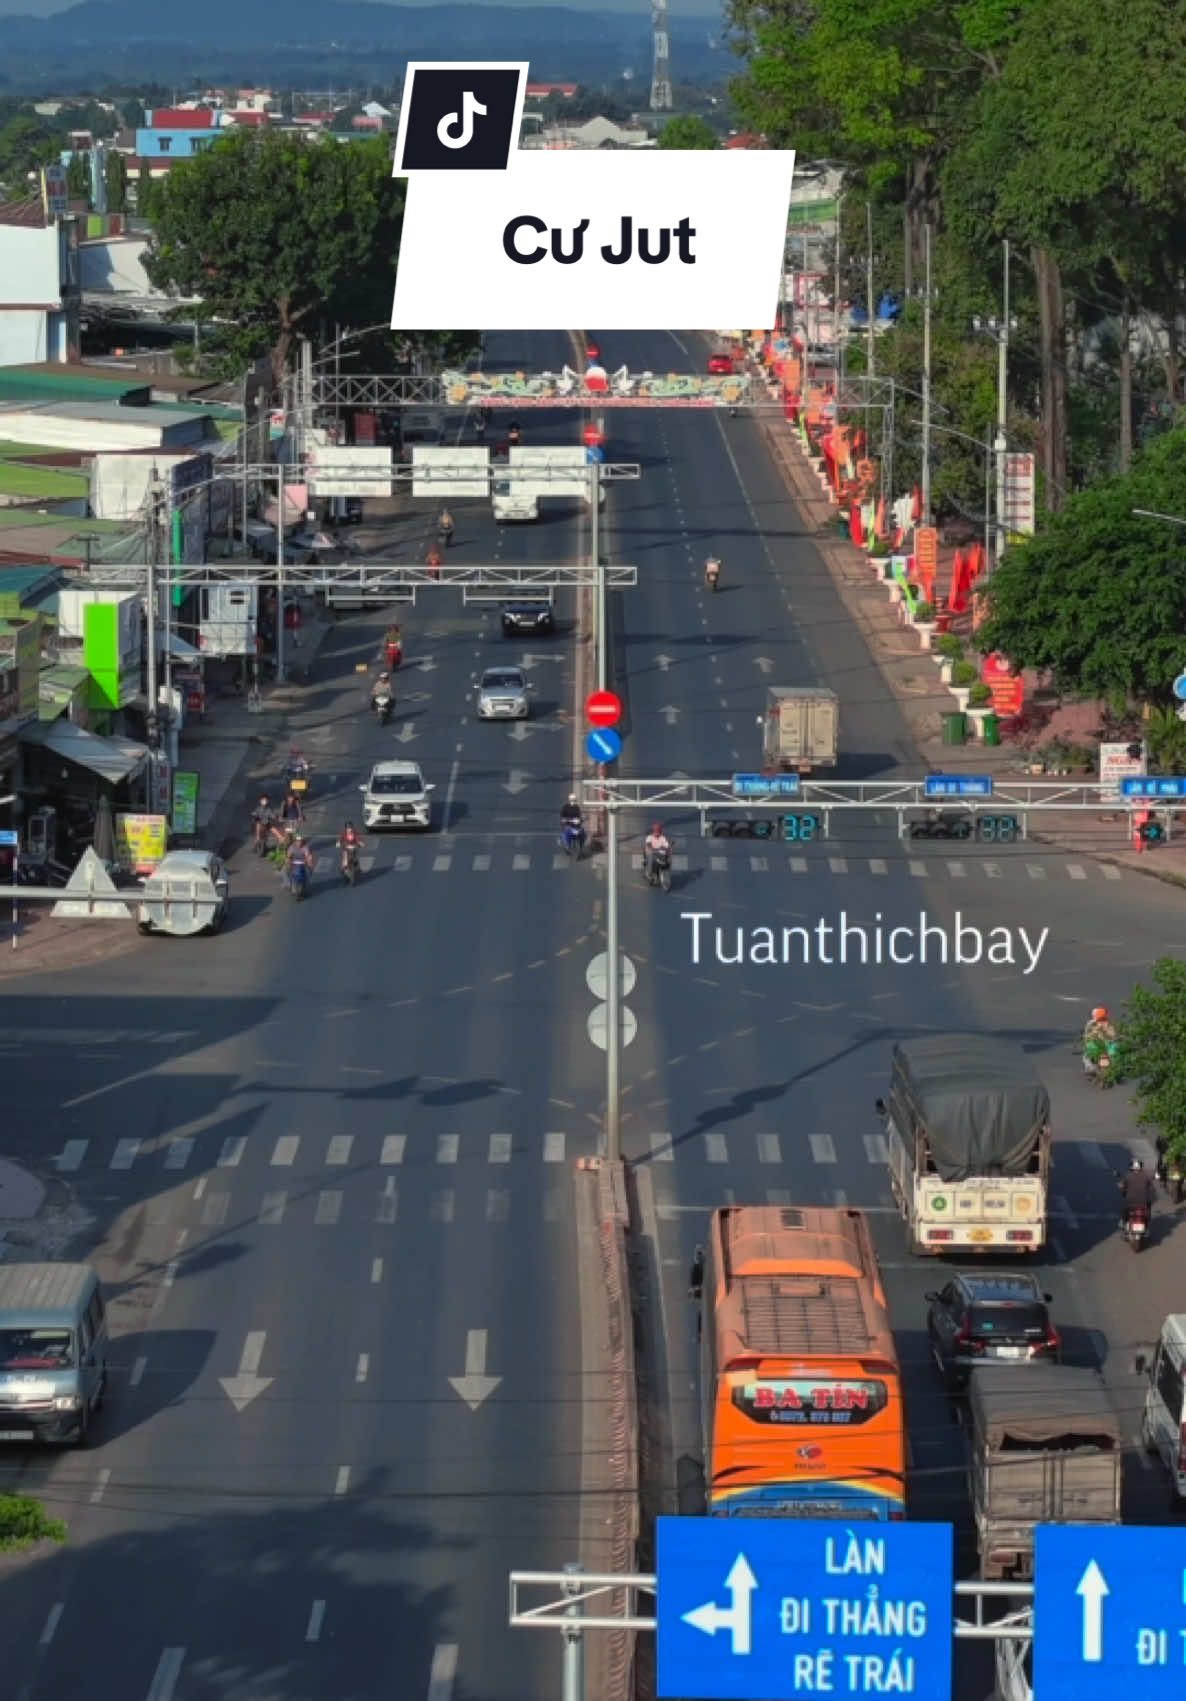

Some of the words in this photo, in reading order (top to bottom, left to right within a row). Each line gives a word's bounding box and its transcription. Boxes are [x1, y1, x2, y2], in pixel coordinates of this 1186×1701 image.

[783, 814, 817, 841] 32
[753, 1386, 803, 1408] BA
[825, 1528, 886, 1575] LÀN
[779, 1596, 810, 1634] ĐI
[821, 1583, 927, 1637] THẲNG
[1136, 1627, 1168, 1665] ĐI
[793, 1647, 834, 1691] RẼ
[843, 1648, 915, 1693] TRÁI
